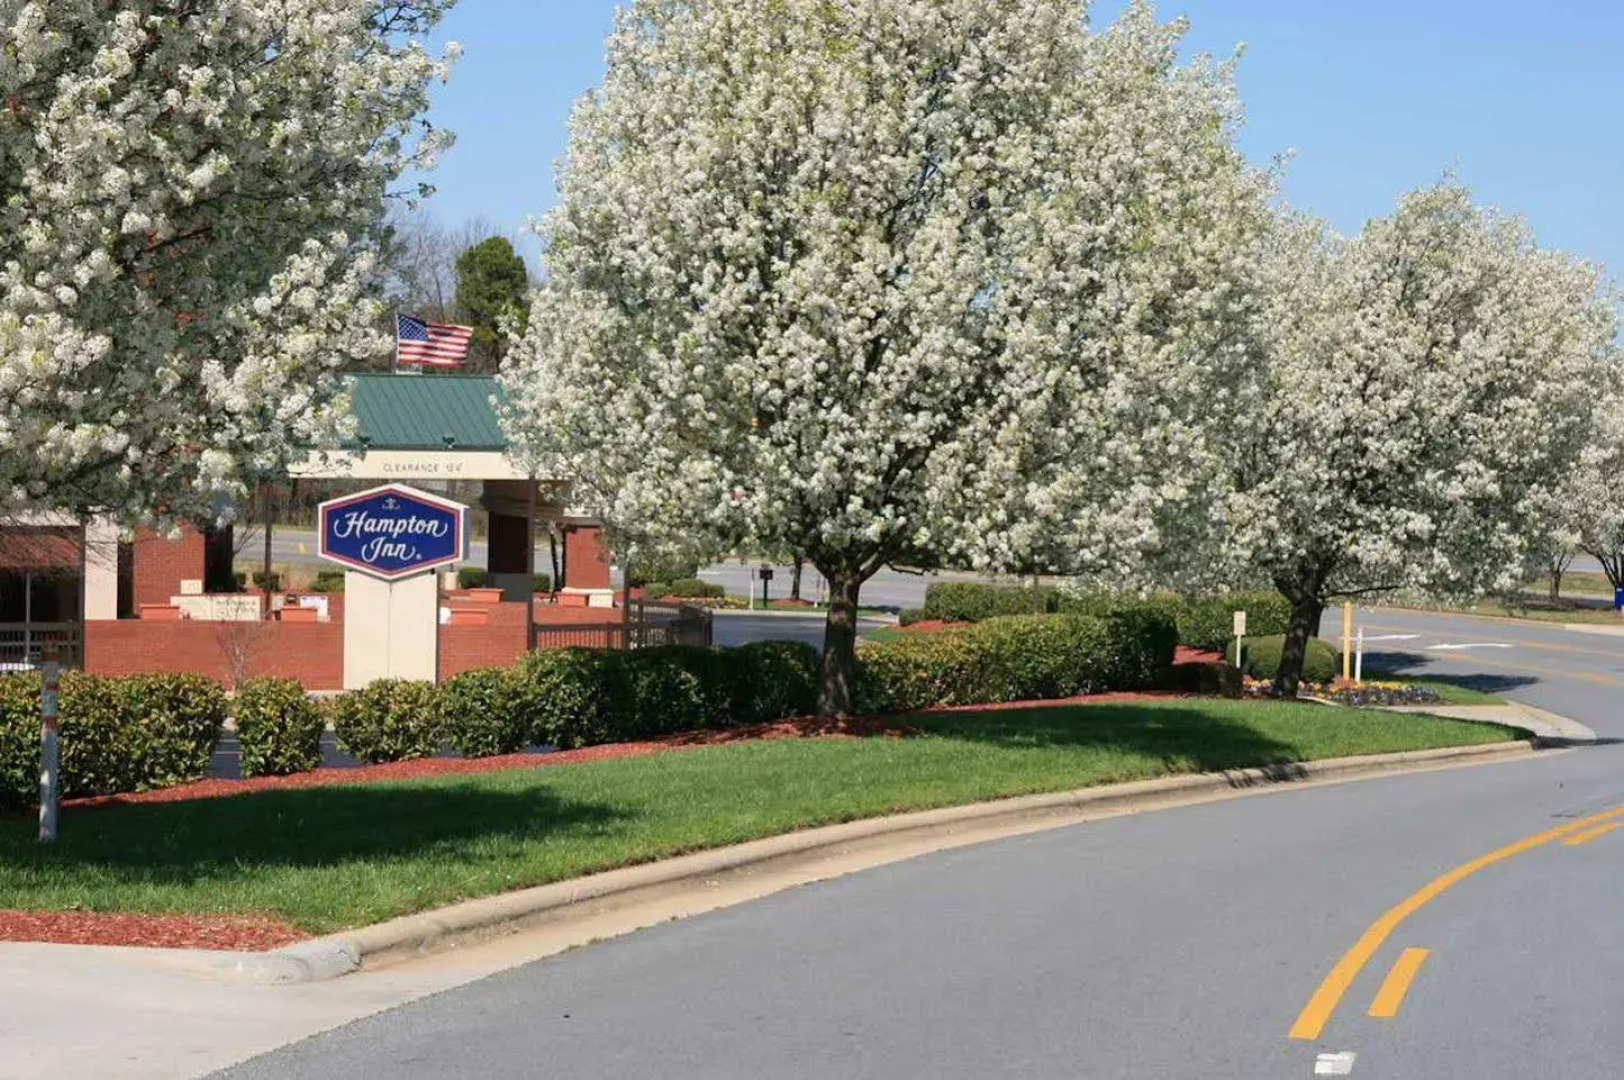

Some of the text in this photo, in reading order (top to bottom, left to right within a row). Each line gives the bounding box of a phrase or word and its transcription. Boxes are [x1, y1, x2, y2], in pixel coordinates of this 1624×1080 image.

[383, 462, 438, 472] CLEARANCE
[333, 511, 448, 539] Hampton
[361, 537, 416, 562] Inn
